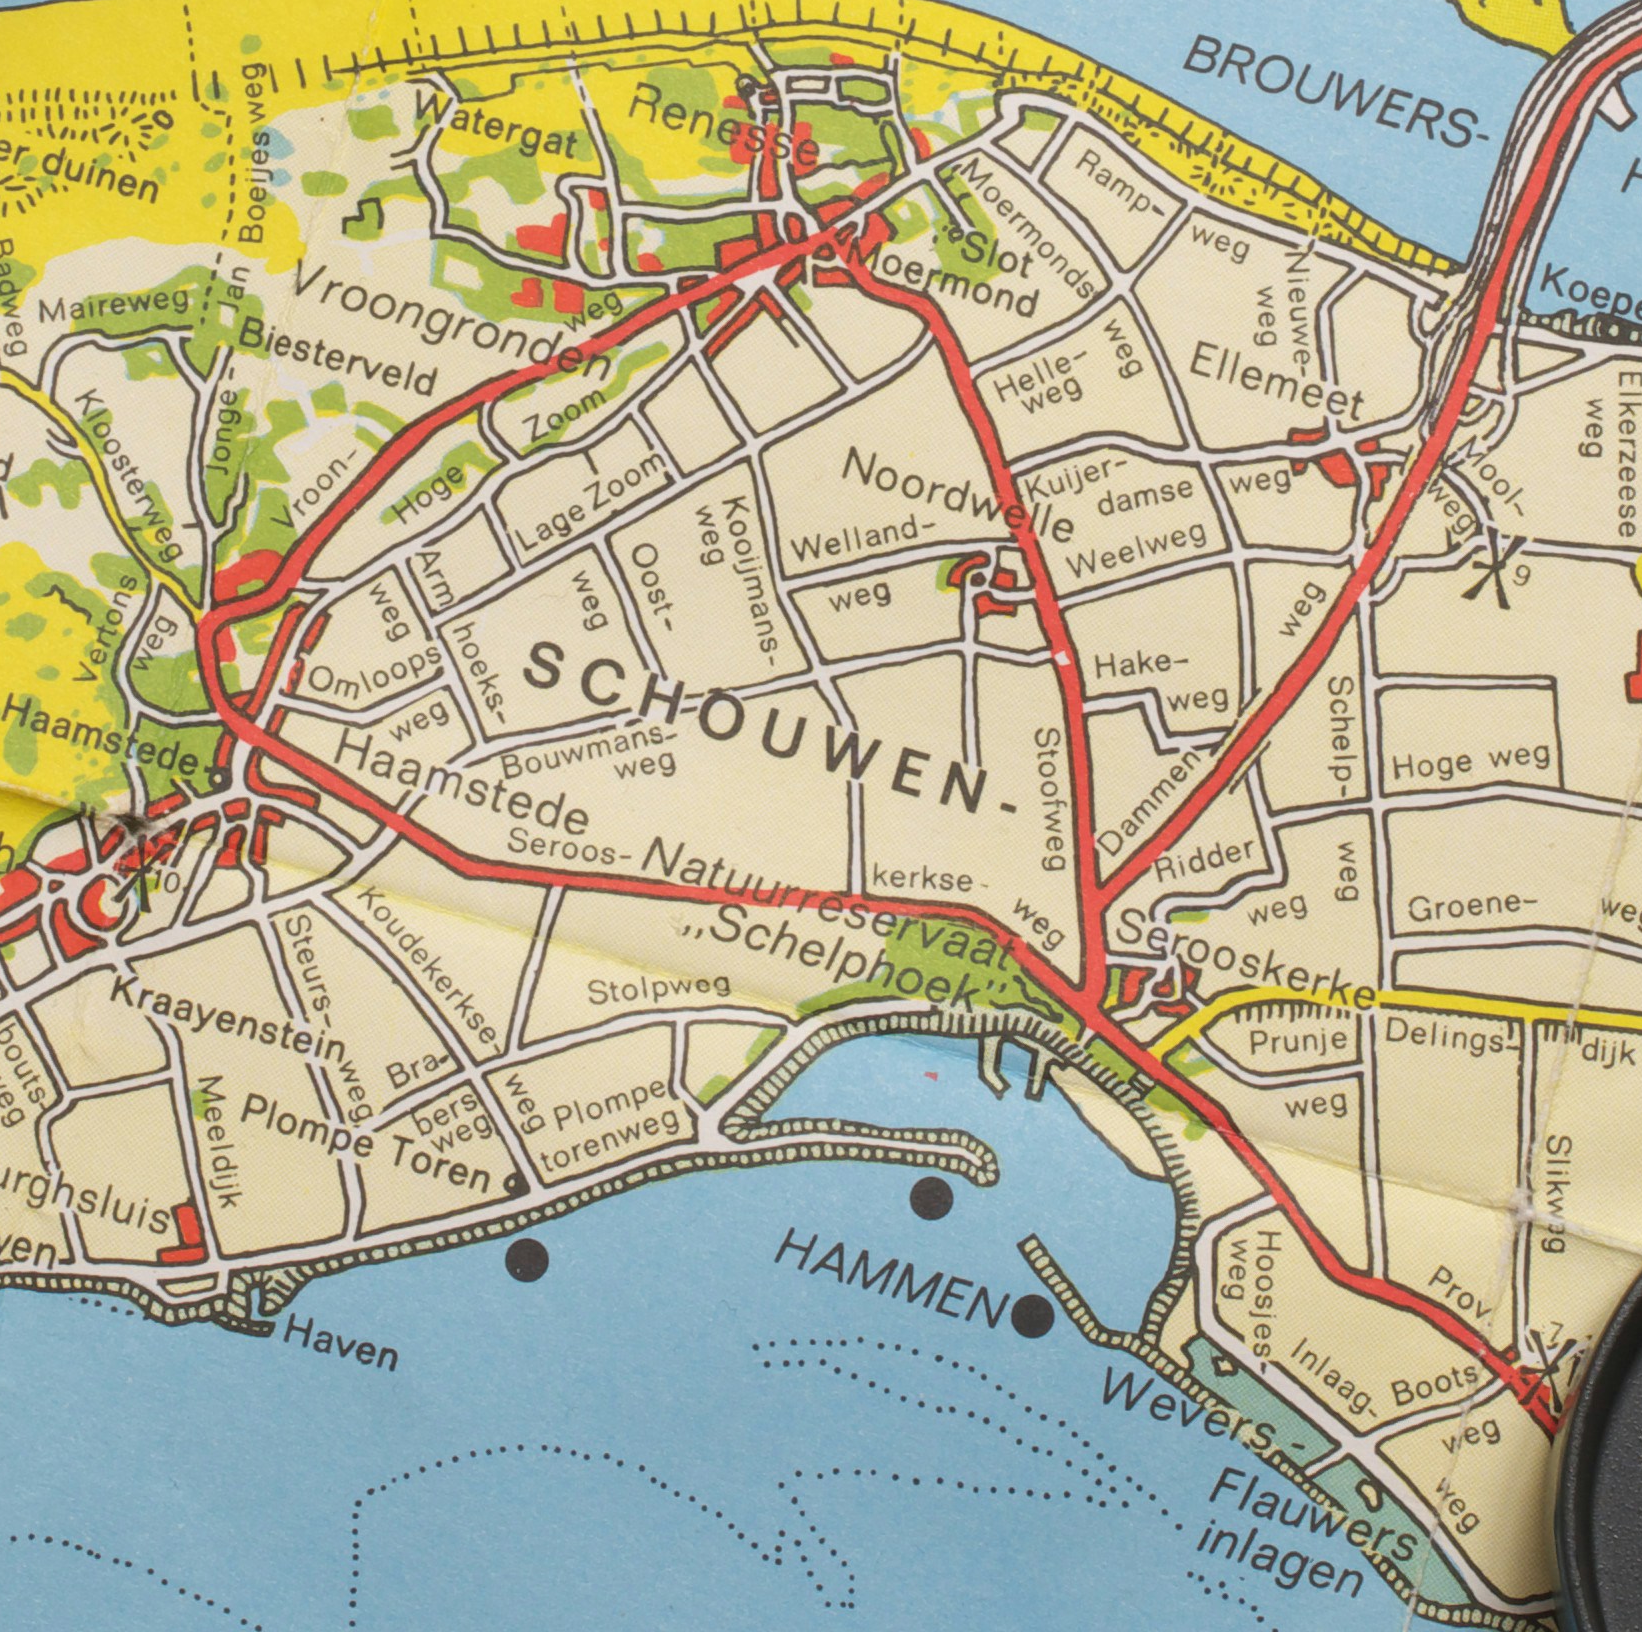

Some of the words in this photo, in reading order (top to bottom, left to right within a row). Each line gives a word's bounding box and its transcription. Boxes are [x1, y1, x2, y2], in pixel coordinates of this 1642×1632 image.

[416, 88, 579, 160] Watergat
[627, 81, 820, 167] Renesse
[1183, 34, 1490, 149] BROUWERS-
[41, 145, 160, 205] duinen
[844, 239, 1040, 320] Moermond
[959, 230, 1034, 281] Slot
[37, 287, 190, 323] Maireweg
[293, 257, 612, 382] Vroongronden
[240, 317, 438, 398] Biesterveld
[1190, 341, 1366, 422] Ellemeet
[73, 387, 185, 564] Kloosterweg
[842, 445, 1075, 545] Noordwelle
[1097, 481, 1194, 517] damse
[1065, 521, 1207, 579] Weelweg
[307, 643, 444, 702] Omloops
[0, 696, 199, 778] Haamstede
[1391, 751, 1473, 781] Hoge
[1488, 743, 1551, 769] weg
[333, 726, 590, 838] Haamstede
[1033, 727, 1068, 873] Stoofweg
[1153, 836, 1256, 884] Ridder
[641, 835, 1017, 971] Natuurreservaat
[587, 974, 732, 1007] Stolpweg
[1114, 908, 1377, 1011] Serooskerke
[110, 977, 347, 1066] Kraayenstein
[1249, 1029, 1349, 1056] Prunje
[1581, 1031, 1637, 1070] dijk
[198, 1075, 244, 1209] Meeldijk
[240, 1092, 376, 1160] Plompe
[391, 1136, 492, 1194] Toren
[773, 1226, 1010, 1330] HAMMEN
[282, 1313, 400, 1372] Haven
[1208, 1466, 1419, 1564] Flauwers
[1197, 1518, 1366, 1600] inlagen
